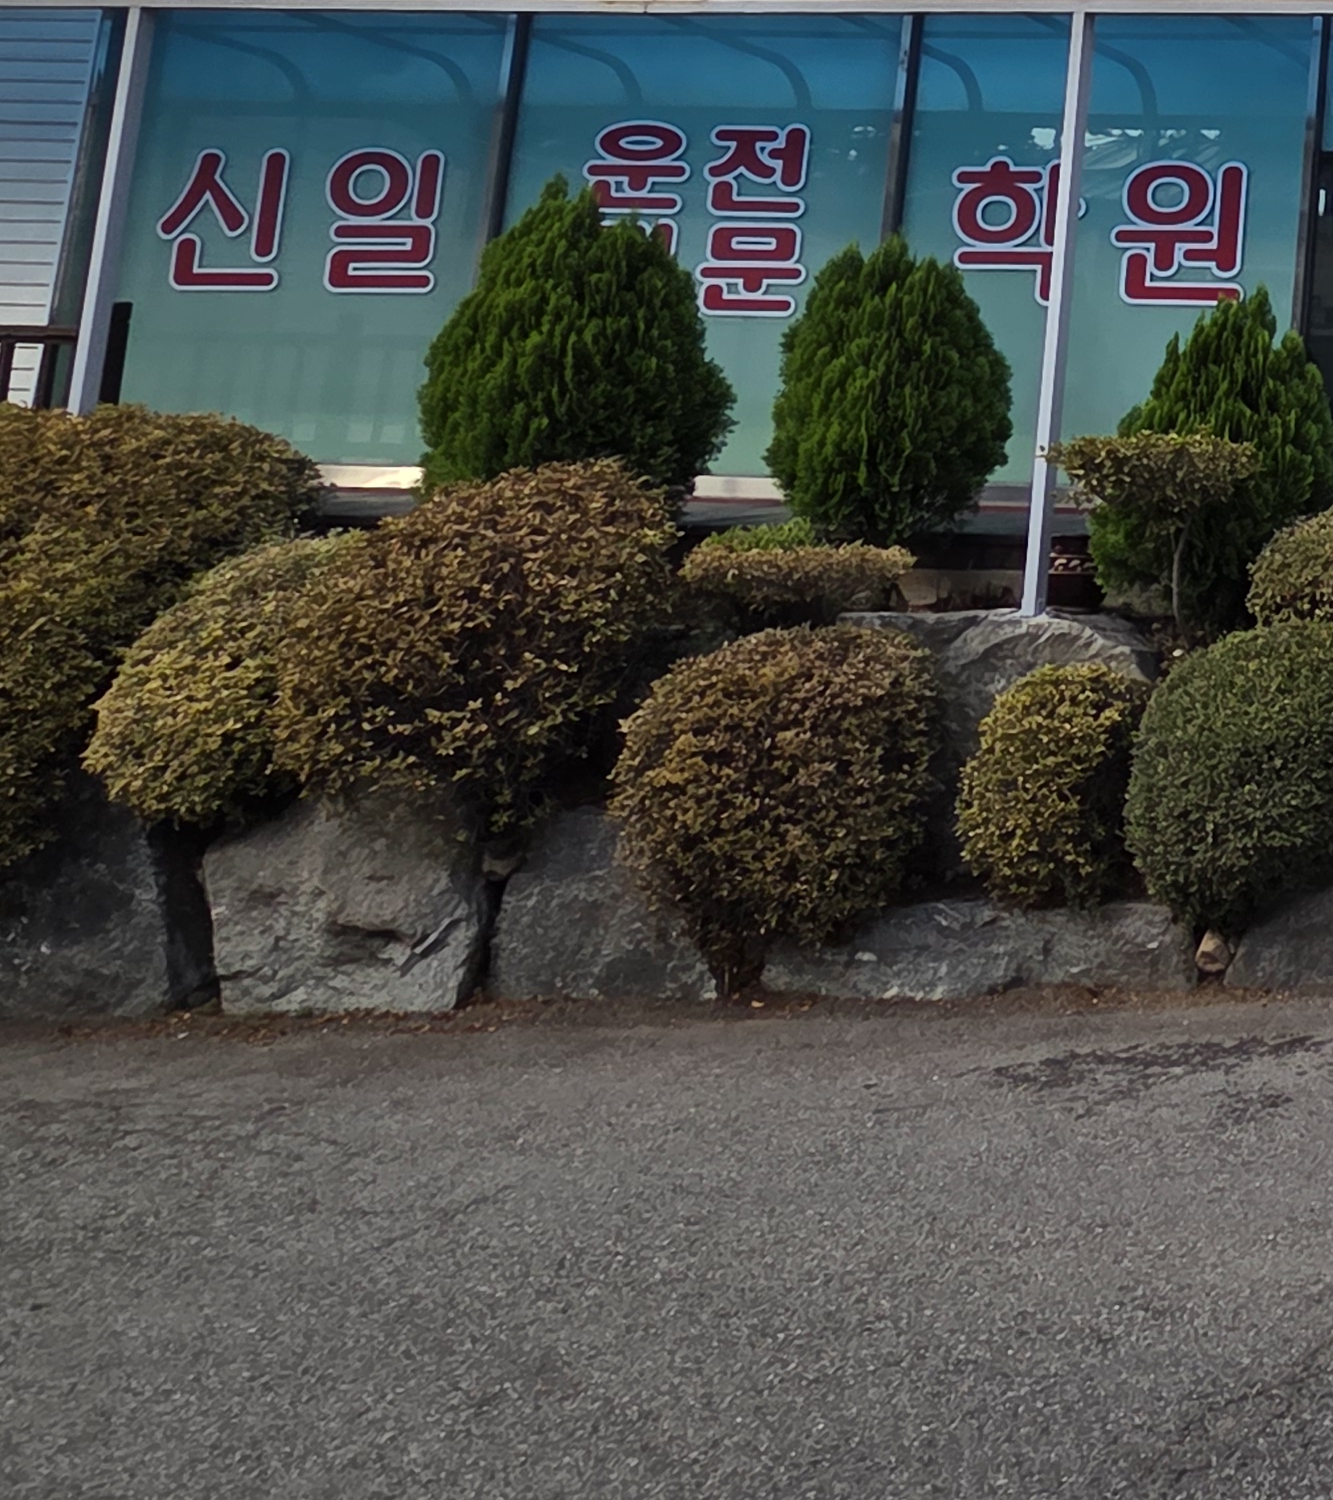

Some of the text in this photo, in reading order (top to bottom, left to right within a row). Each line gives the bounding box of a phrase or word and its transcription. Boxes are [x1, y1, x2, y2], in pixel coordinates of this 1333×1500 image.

[156, 148, 446, 294] 신일
[586, 120, 811, 219] 운전
[953, 155, 1248, 306] 학원
[600, 217, 807, 317] 문
